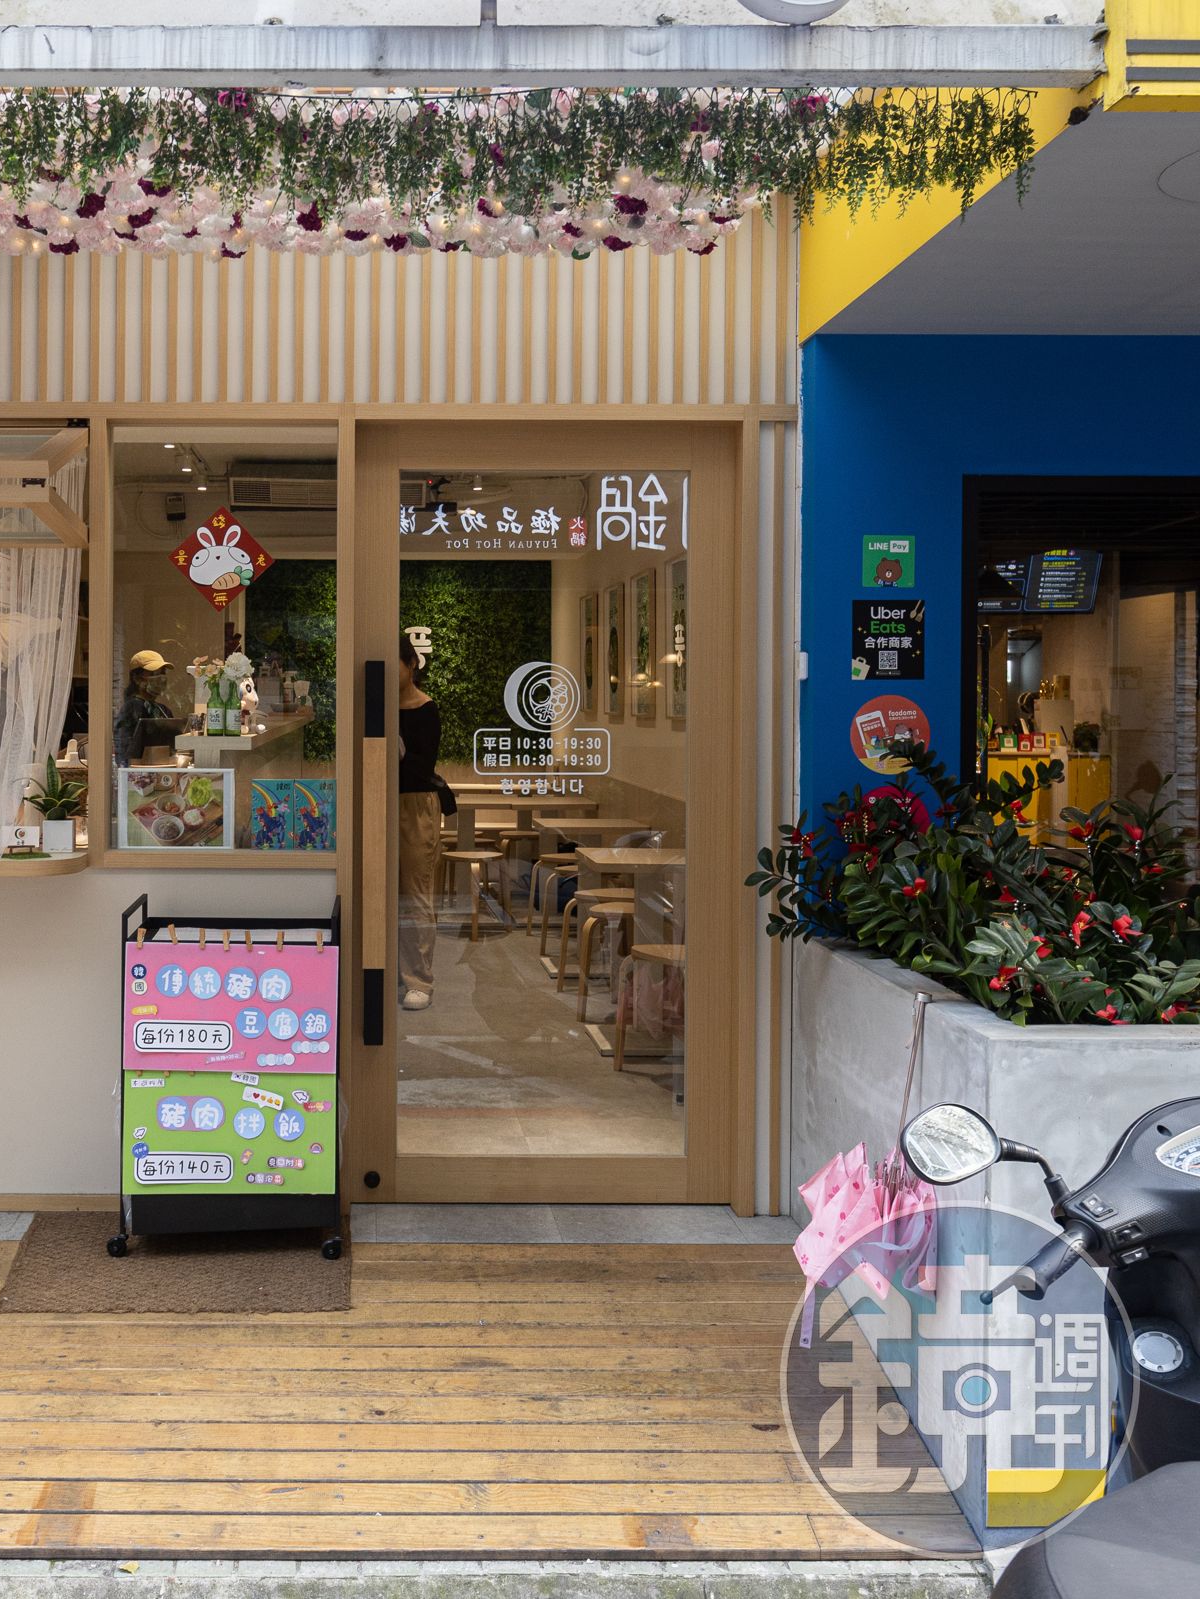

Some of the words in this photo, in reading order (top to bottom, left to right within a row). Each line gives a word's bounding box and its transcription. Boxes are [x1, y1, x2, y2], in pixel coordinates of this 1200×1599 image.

[868, 542, 889, 550] LINE
[892, 543, 907, 553] Pay
[870, 606, 906, 619] Uber
[870, 621, 906, 634] Eats
[864, 636, 913, 649] 合作商家
[483, 737, 511, 750] 平日
[517, 737, 601, 750] 10:30-19:30
[483, 753, 511, 767] 假日
[515, 754, 601, 766] 10:30-19:30
[500, 778, 584, 795] 환영합니다
[161, 968, 286, 999] 傳統豬肉
[243, 1011, 327, 1038] 豆腐鍋
[141, 1027, 224, 1045] 每份180元
[142, 1160, 225, 1177] 每份140元
